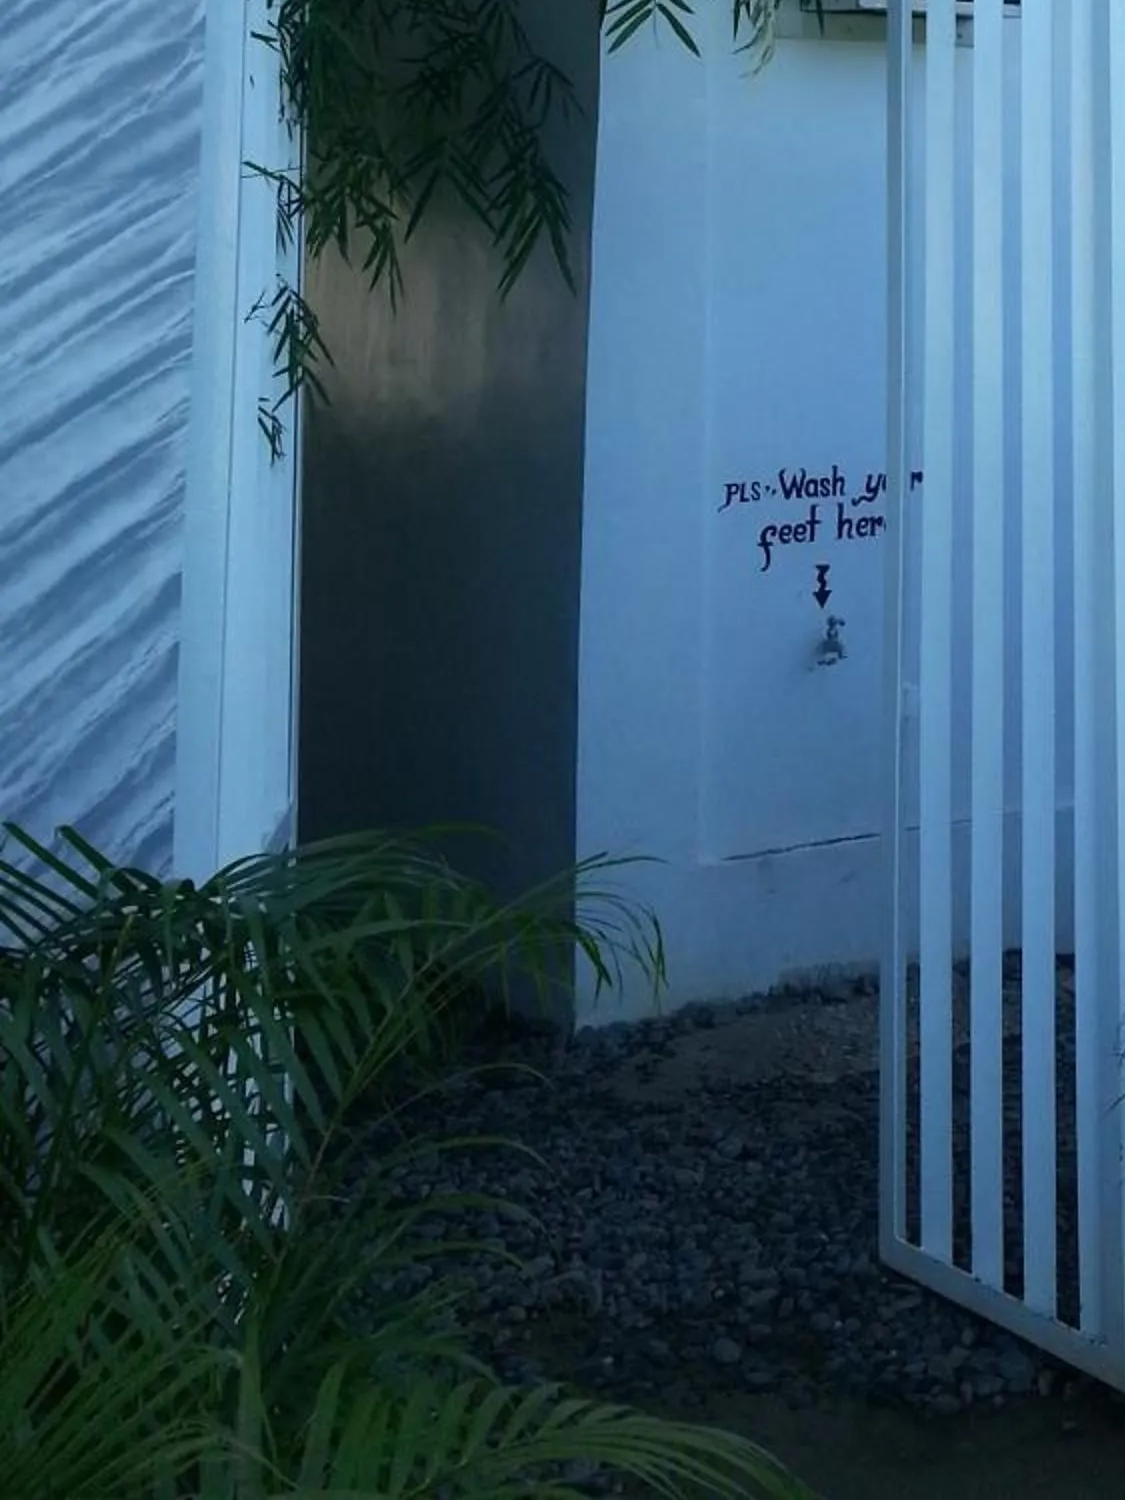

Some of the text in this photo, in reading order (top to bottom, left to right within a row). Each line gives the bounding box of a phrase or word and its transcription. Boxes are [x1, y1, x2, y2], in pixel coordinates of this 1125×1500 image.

[778, 465, 846, 500] Wash
[851, 471, 923, 507] yr
[756, 502, 887, 572] feet her
